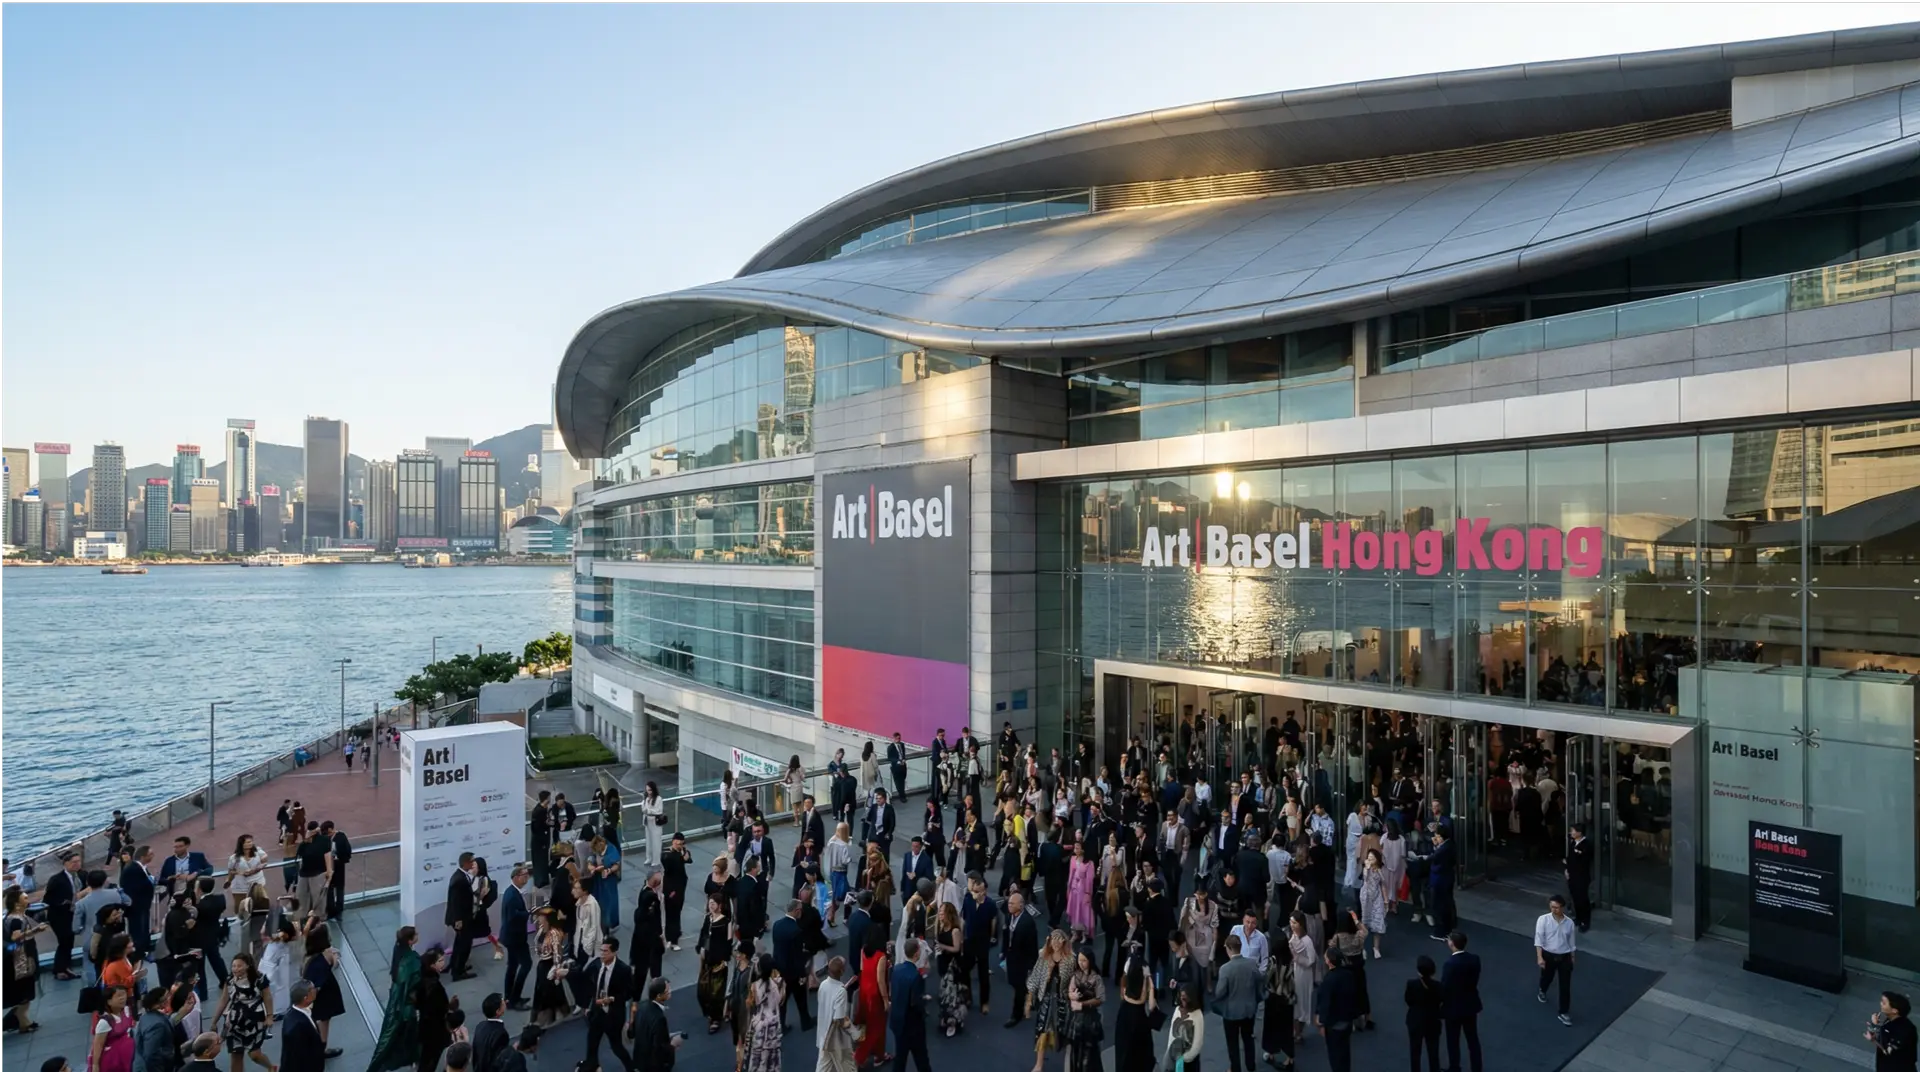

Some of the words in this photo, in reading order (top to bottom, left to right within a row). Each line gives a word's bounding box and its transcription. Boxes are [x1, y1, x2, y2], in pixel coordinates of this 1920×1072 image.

[832, 493, 867, 539] Art
[878, 485, 952, 539] Basel
[1142, 526, 1191, 568] Art
[1206, 522, 1310, 568] Basel
[1323, 521, 1443, 575] Hong
[1457, 518, 1602, 577] Kong
[423, 748, 450, 766] Art
[1712, 741, 1733, 755] Art
[1740, 744, 1778, 761] Basel
[423, 764, 469, 787] Basel
[1771, 831, 1797, 845] Basel
